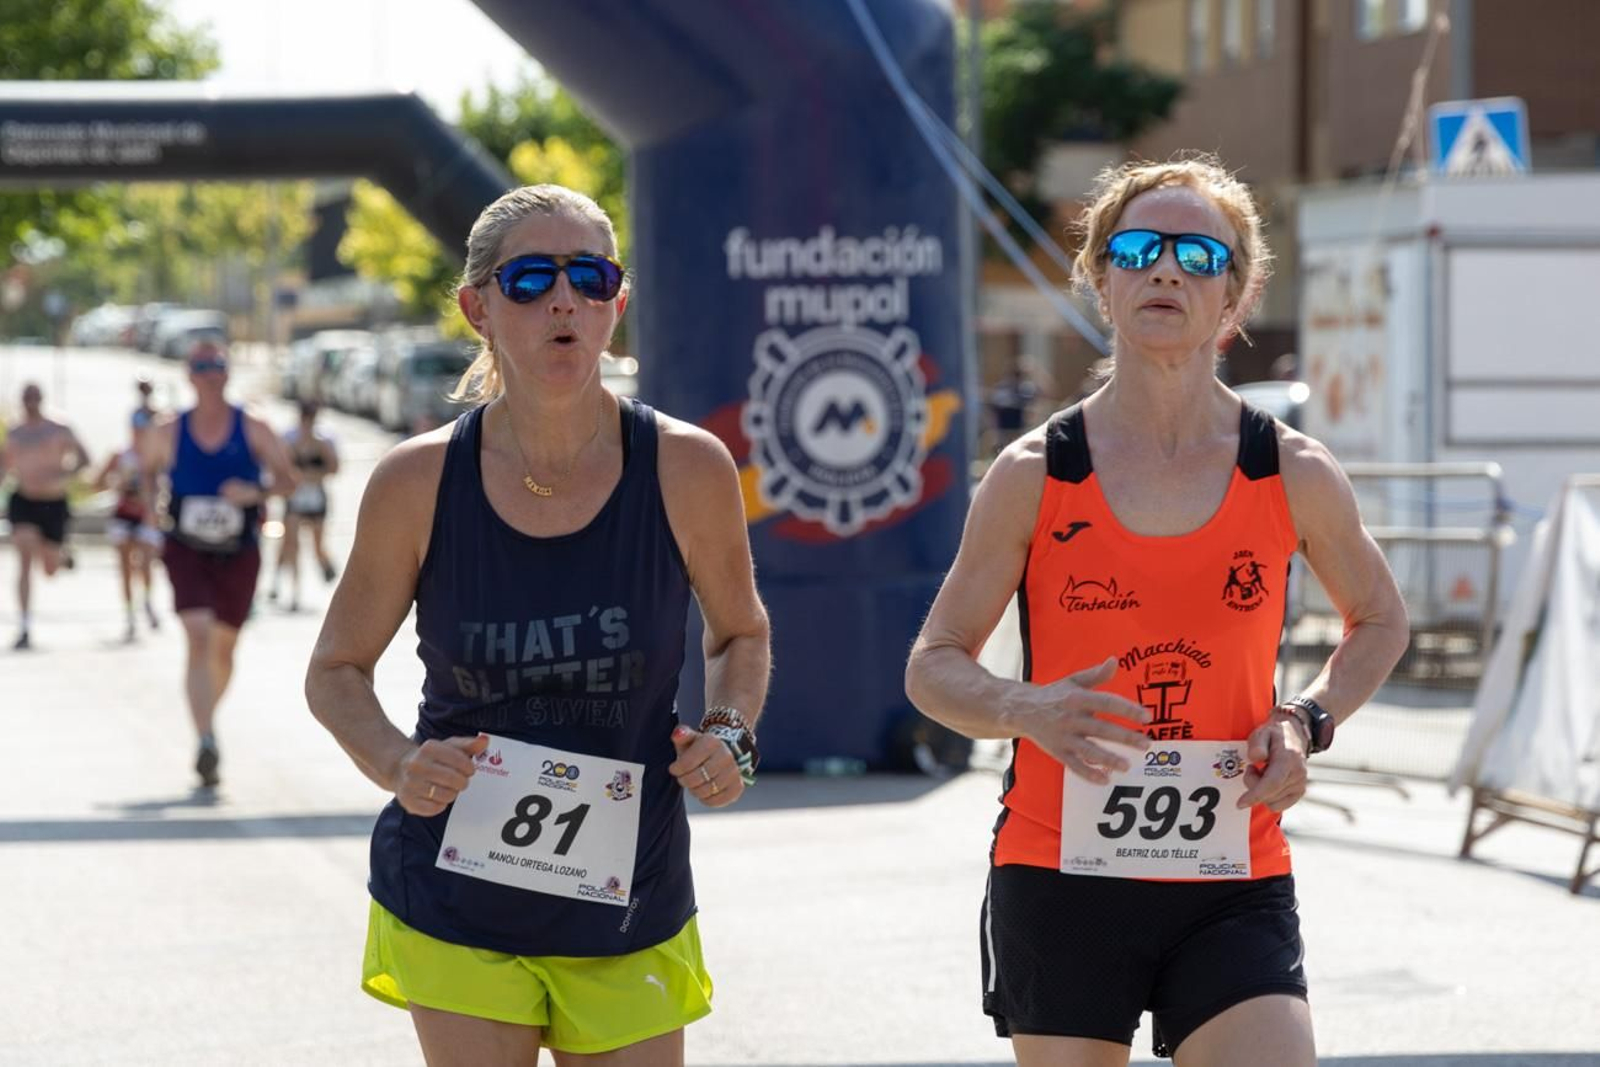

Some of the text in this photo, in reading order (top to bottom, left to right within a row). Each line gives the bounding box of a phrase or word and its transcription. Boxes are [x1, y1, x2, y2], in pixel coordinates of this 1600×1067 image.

[725, 226, 942, 278] fundación
[766, 277, 909, 328] mupol
[1065, 591, 1141, 612] Tentación
[1118, 638, 1212, 671] Macchiato
[452, 650, 646, 704] GLITTER
[524, 696, 631, 729] SWEA
[1138, 721, 1194, 740] AFFÈ
[501, 795, 591, 856] 81
[1097, 785, 1221, 841] 593
[488, 850, 588, 879] MANOLI ORTEGA LOZANO
[1116, 847, 1150, 859] BEATRIZ
[1170, 846, 1199, 859] TÉLLEZ
[578, 890, 626, 903] NACIONAL
